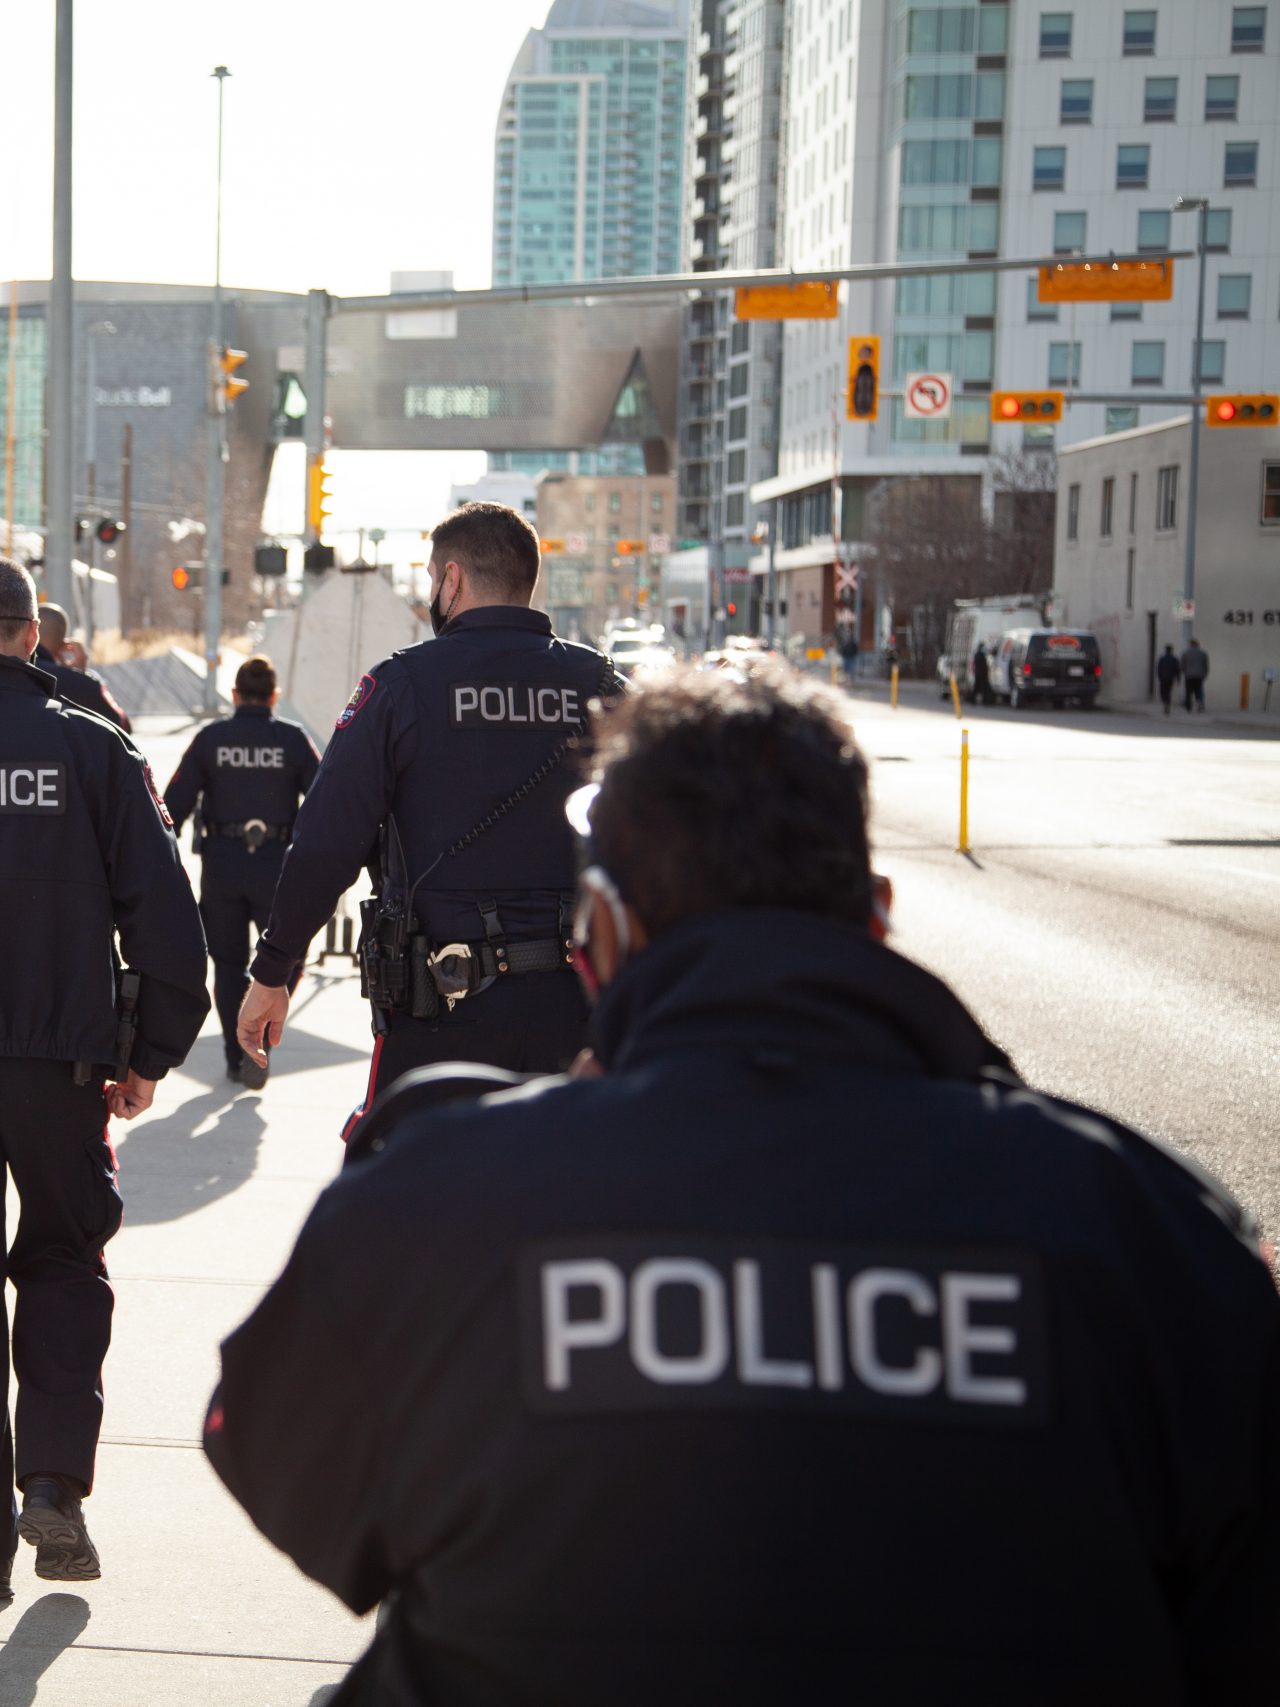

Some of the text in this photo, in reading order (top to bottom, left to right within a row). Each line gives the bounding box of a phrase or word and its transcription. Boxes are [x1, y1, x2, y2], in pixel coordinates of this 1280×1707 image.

[1223, 609, 1253, 626] 431
[454, 686, 581, 724] POLICE
[217, 746, 284, 768] POLICE
[541, 1258, 1024, 1404] POLICE
